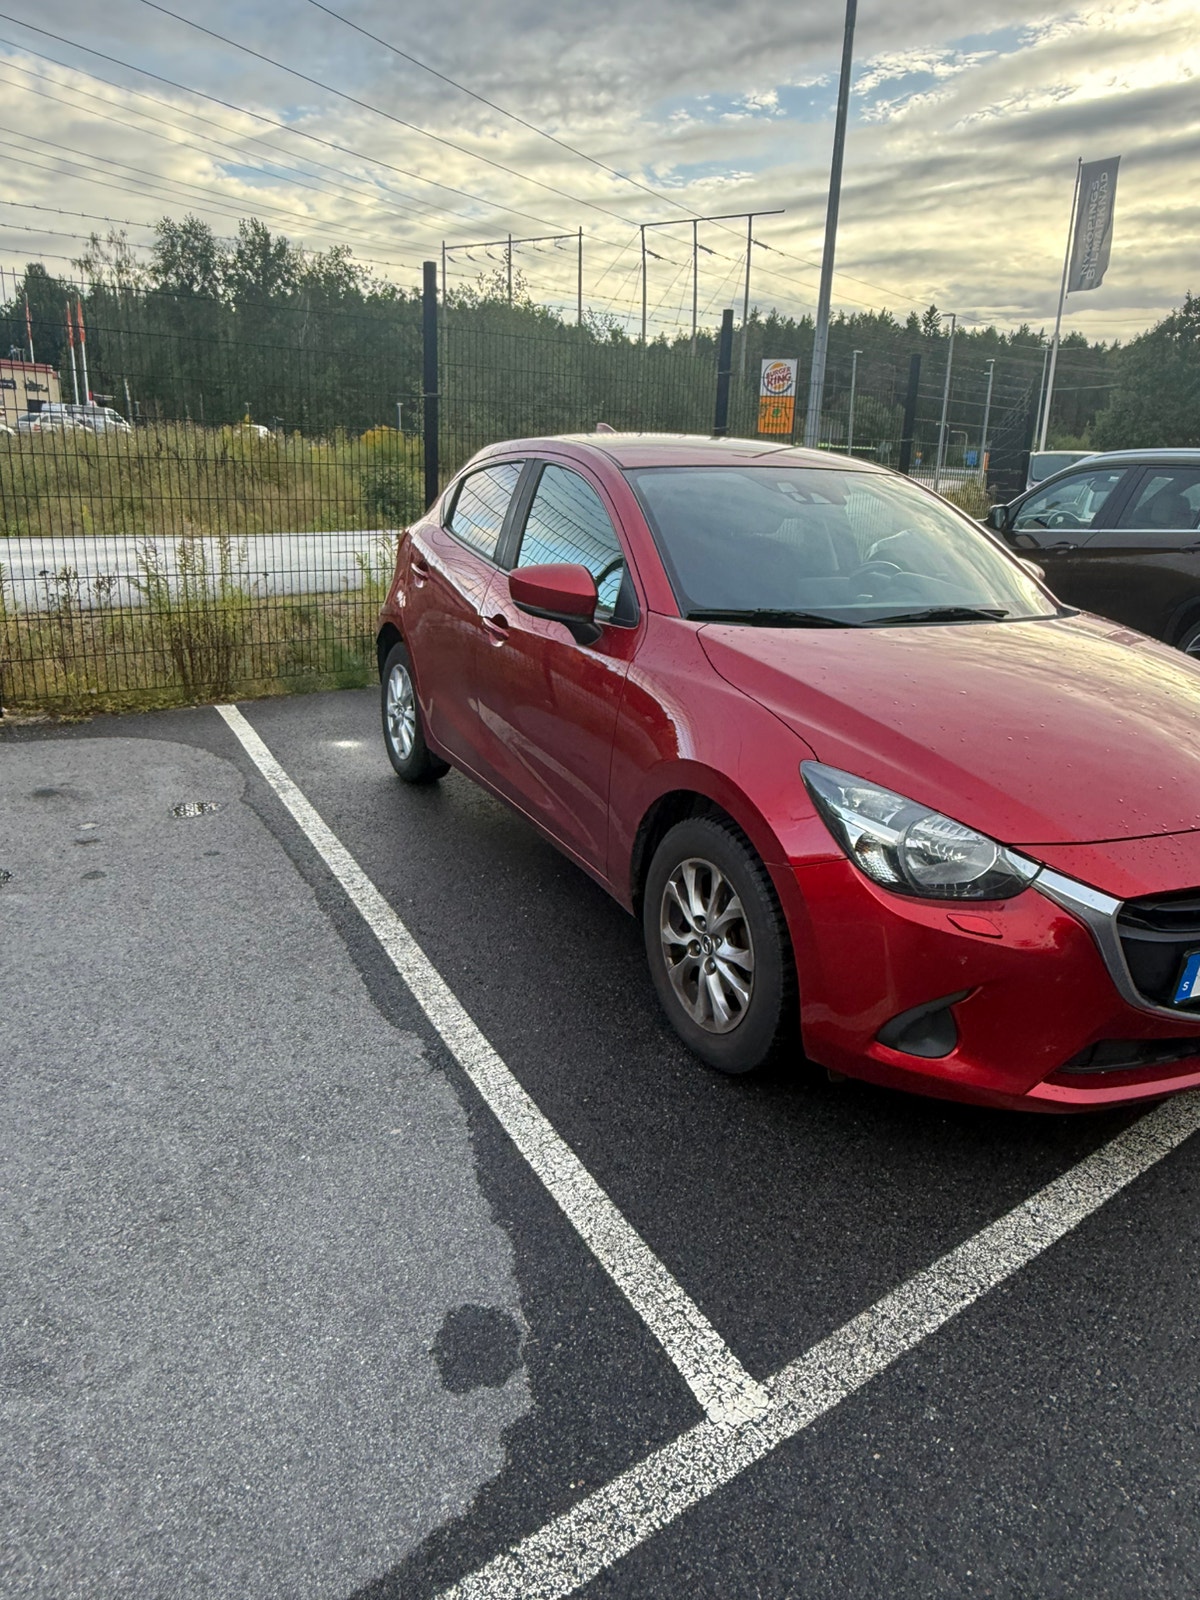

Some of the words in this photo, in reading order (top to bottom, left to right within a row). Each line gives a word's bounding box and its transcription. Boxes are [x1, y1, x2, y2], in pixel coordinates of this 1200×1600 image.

[1086, 172, 1109, 280] BILMARKNAD
[766, 366, 791, 379] BURGER
[766, 373, 792, 387] KING
[1182, 981, 1190, 991] S
